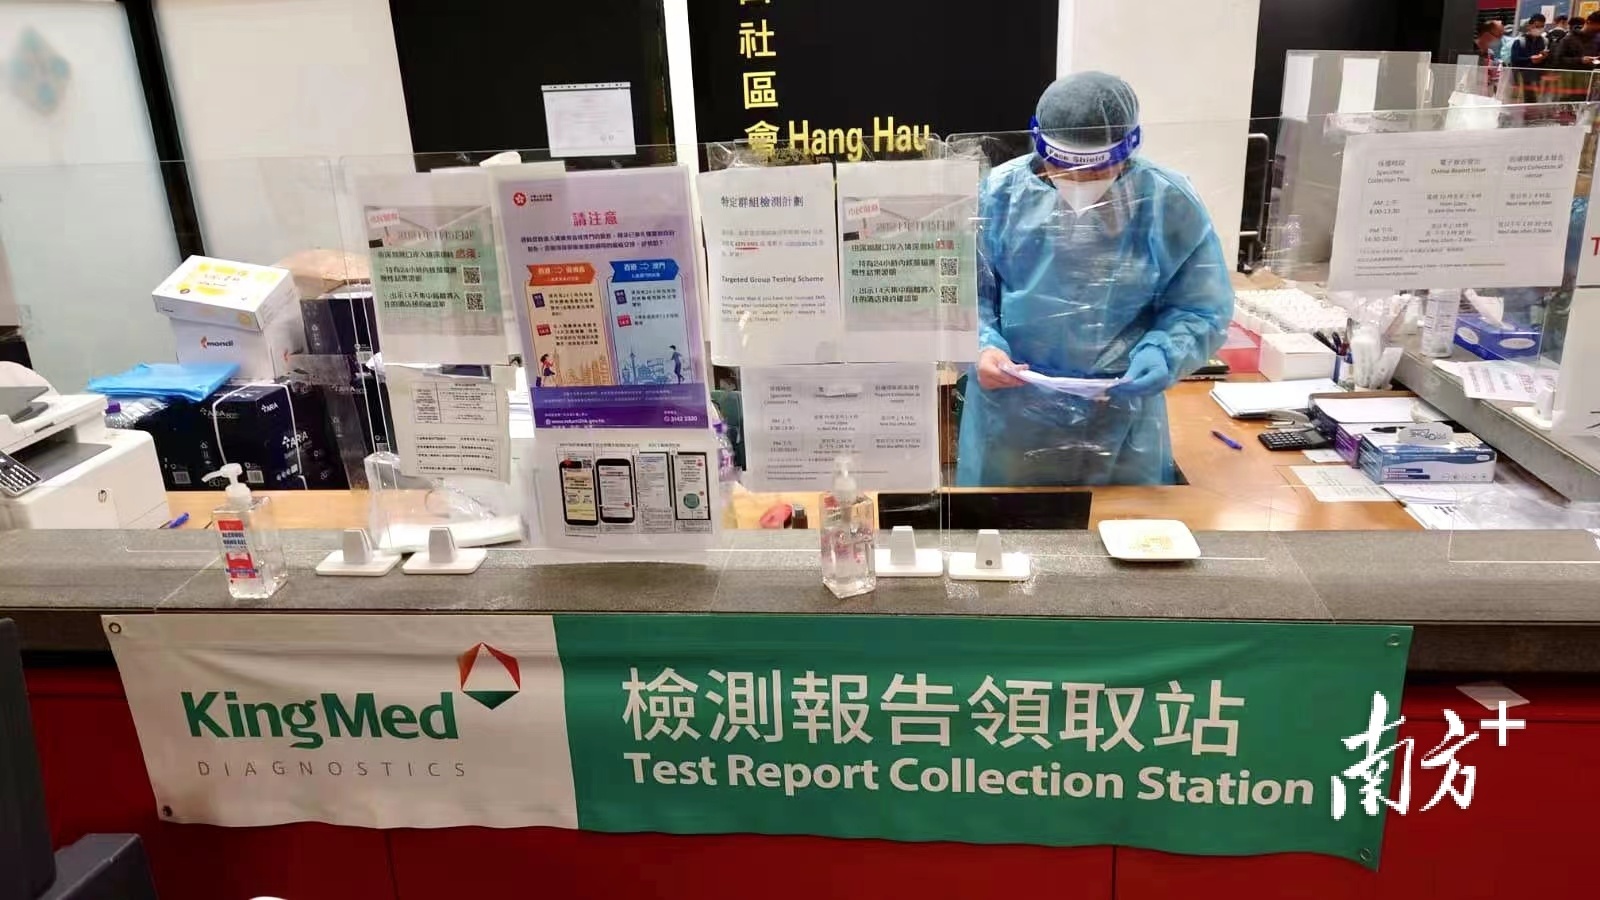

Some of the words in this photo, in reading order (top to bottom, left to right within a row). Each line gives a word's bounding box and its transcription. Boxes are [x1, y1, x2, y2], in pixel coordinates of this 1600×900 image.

[738, 0, 780, 157] 社區會
[788, 120, 863, 162] Hang
[873, 116, 930, 153] Hau
[1048, 147, 1070, 161] Face
[1072, 154, 1106, 164] Shield
[720, 195, 804, 208] 特定群組檢測計劃
[572, 210, 618, 228] 請注意
[721, 276, 749, 284] Targeted
[749, 276, 771, 284] Group
[772, 275, 796, 283] Testing
[797, 275, 824, 283] Scheme
[206, 339, 234, 348] mondi
[265, 402, 279, 412] ARA
[290, 431, 309, 448] ARA
[180, 691, 459, 749] KingMed
[622, 666, 1245, 757] 檢測報告領取站
[197, 760, 466, 778] DIAGNOSTICS
[624, 752, 717, 786] Test
[727, 754, 879, 796] Report
[889, 757, 1124, 799] Collection
[1137, 766, 1314, 806] Station
